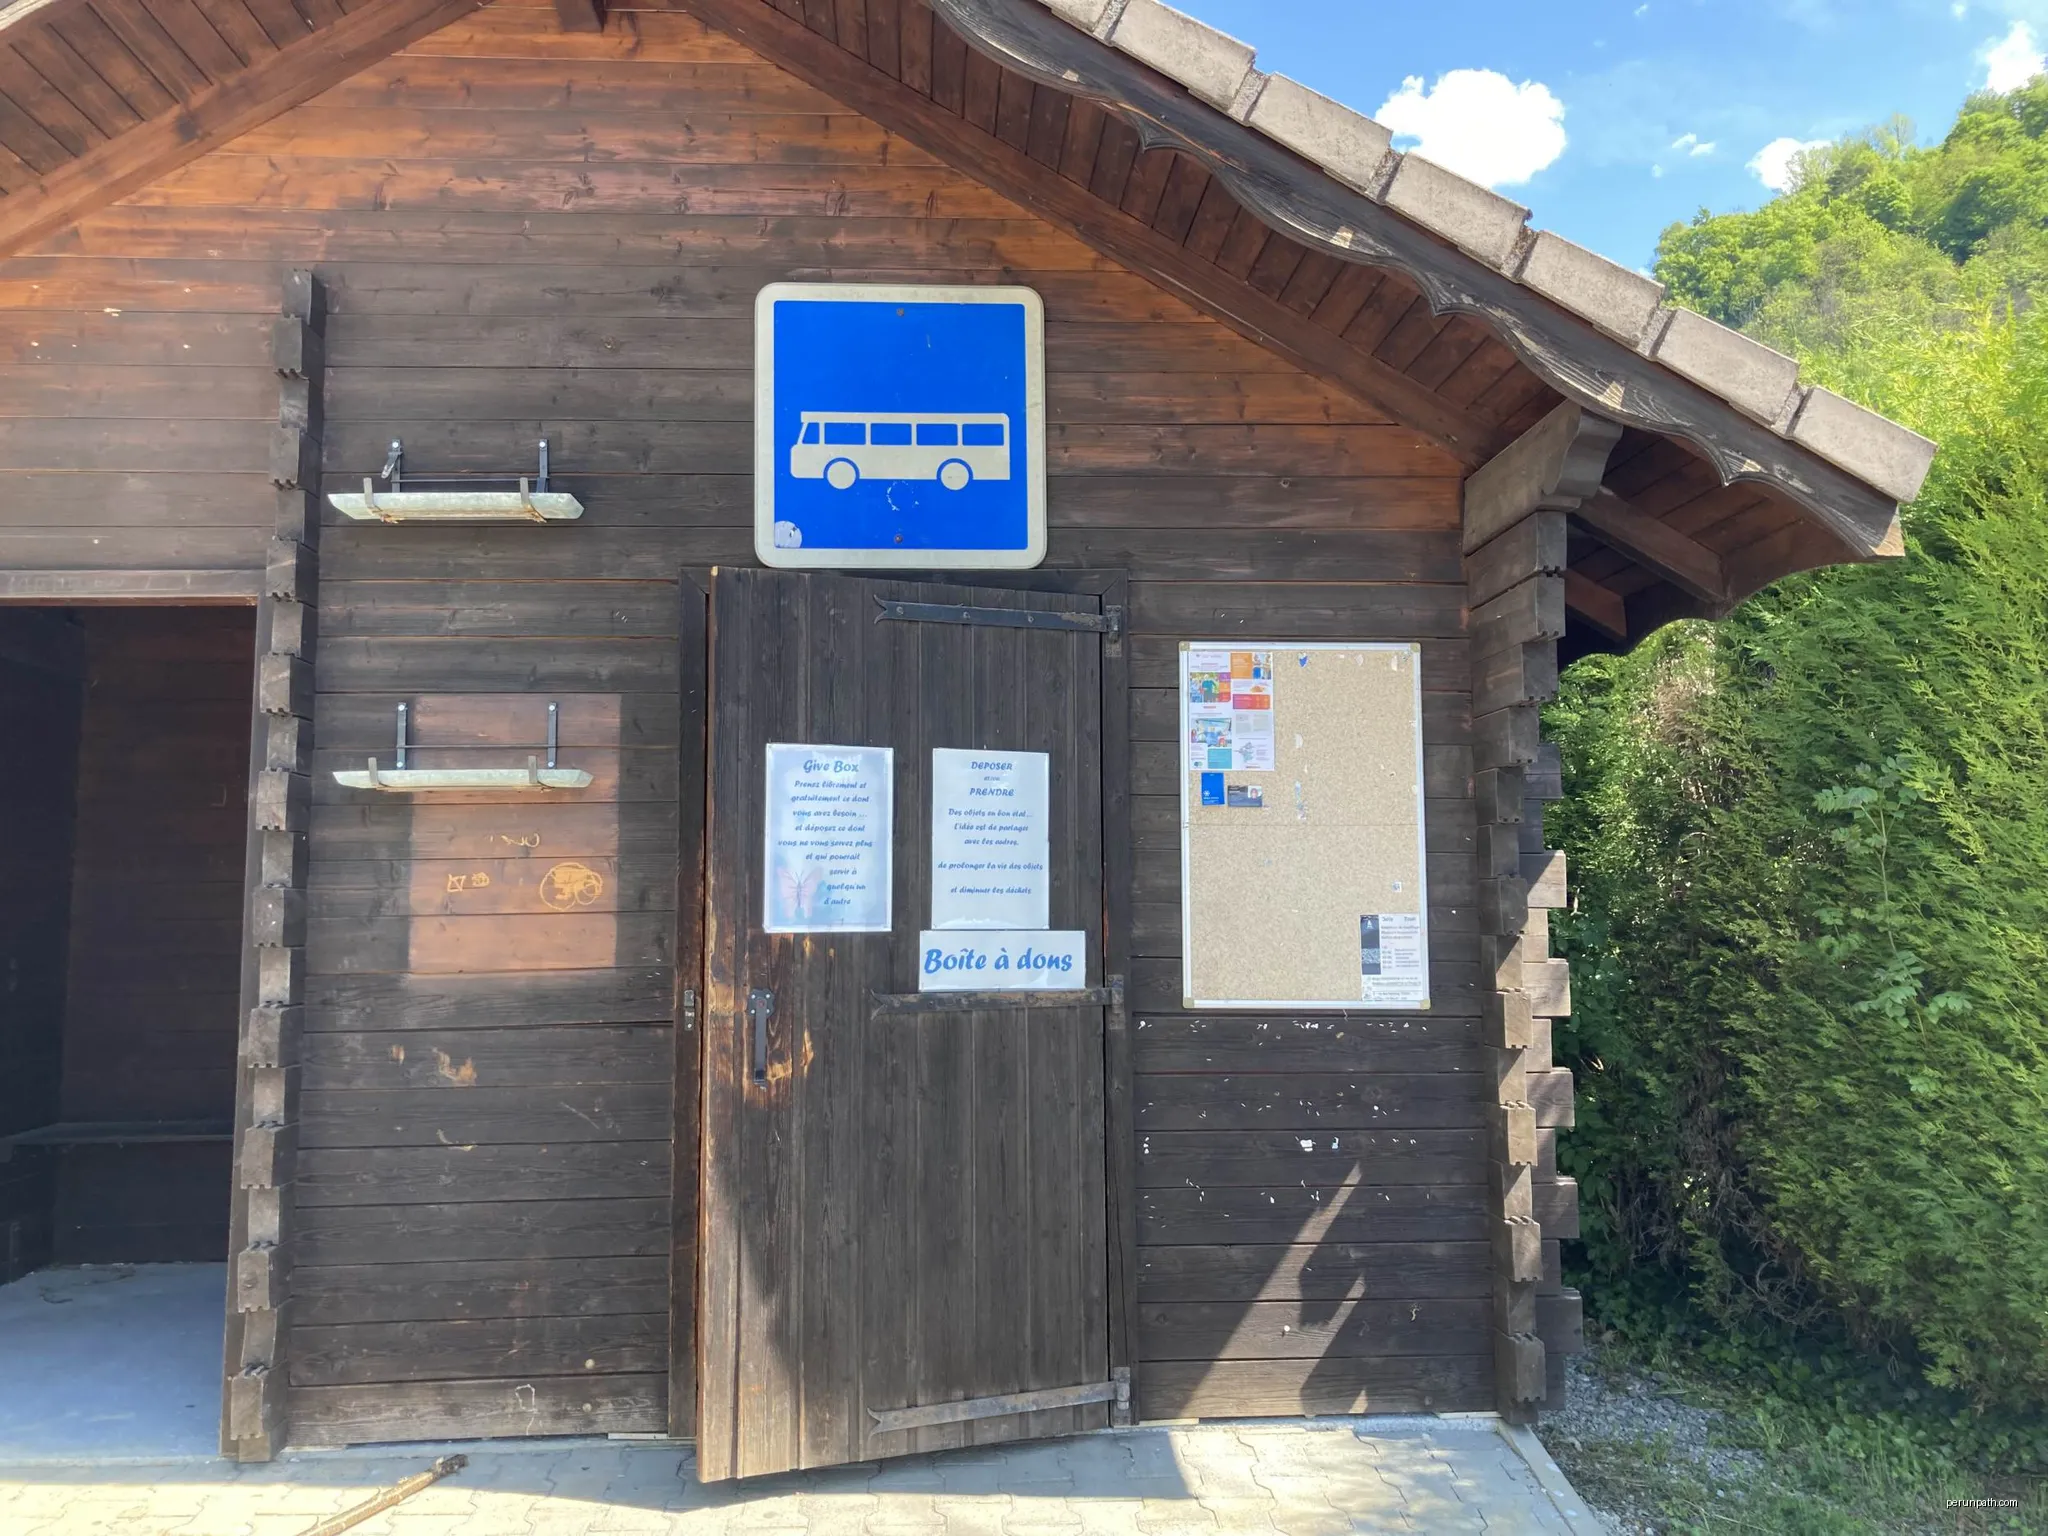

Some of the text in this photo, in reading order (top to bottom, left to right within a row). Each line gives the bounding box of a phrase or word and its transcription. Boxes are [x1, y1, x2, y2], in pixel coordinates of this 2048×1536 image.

[803, 759, 860, 774] Give Box
[971, 761, 1013, 770] DEPOSER
[794, 780, 820, 788] Prenez
[822, 781, 857, 789] librement
[969, 787, 1015, 797] PRENDRE
[790, 794, 841, 802] gratuitement
[832, 809, 857, 818] besoin
[948, 808, 962, 816] Des
[964, 808, 986, 818] objets
[997, 809, 1011, 817] bon
[847, 824, 865, 832] dont
[975, 823, 986, 831] est
[988, 823, 997, 831] de
[998, 824, 1029, 833] partager
[778, 839, 797, 847] vous
[810, 839, 829, 847] vous
[855, 839, 873, 848] plus
[981, 837, 993, 845] les
[805, 852, 860, 861] et qui pourrait
[938, 861, 947, 869] de
[948, 861, 985, 870] prolonger
[1009, 862, 1021, 870] des
[1022, 862, 1043, 871] objets
[829, 867, 850, 875] servir
[959, 886, 990, 894] diminuer
[992, 886, 1004, 894] les
[923, 947, 1073, 974] Boîte à dons
